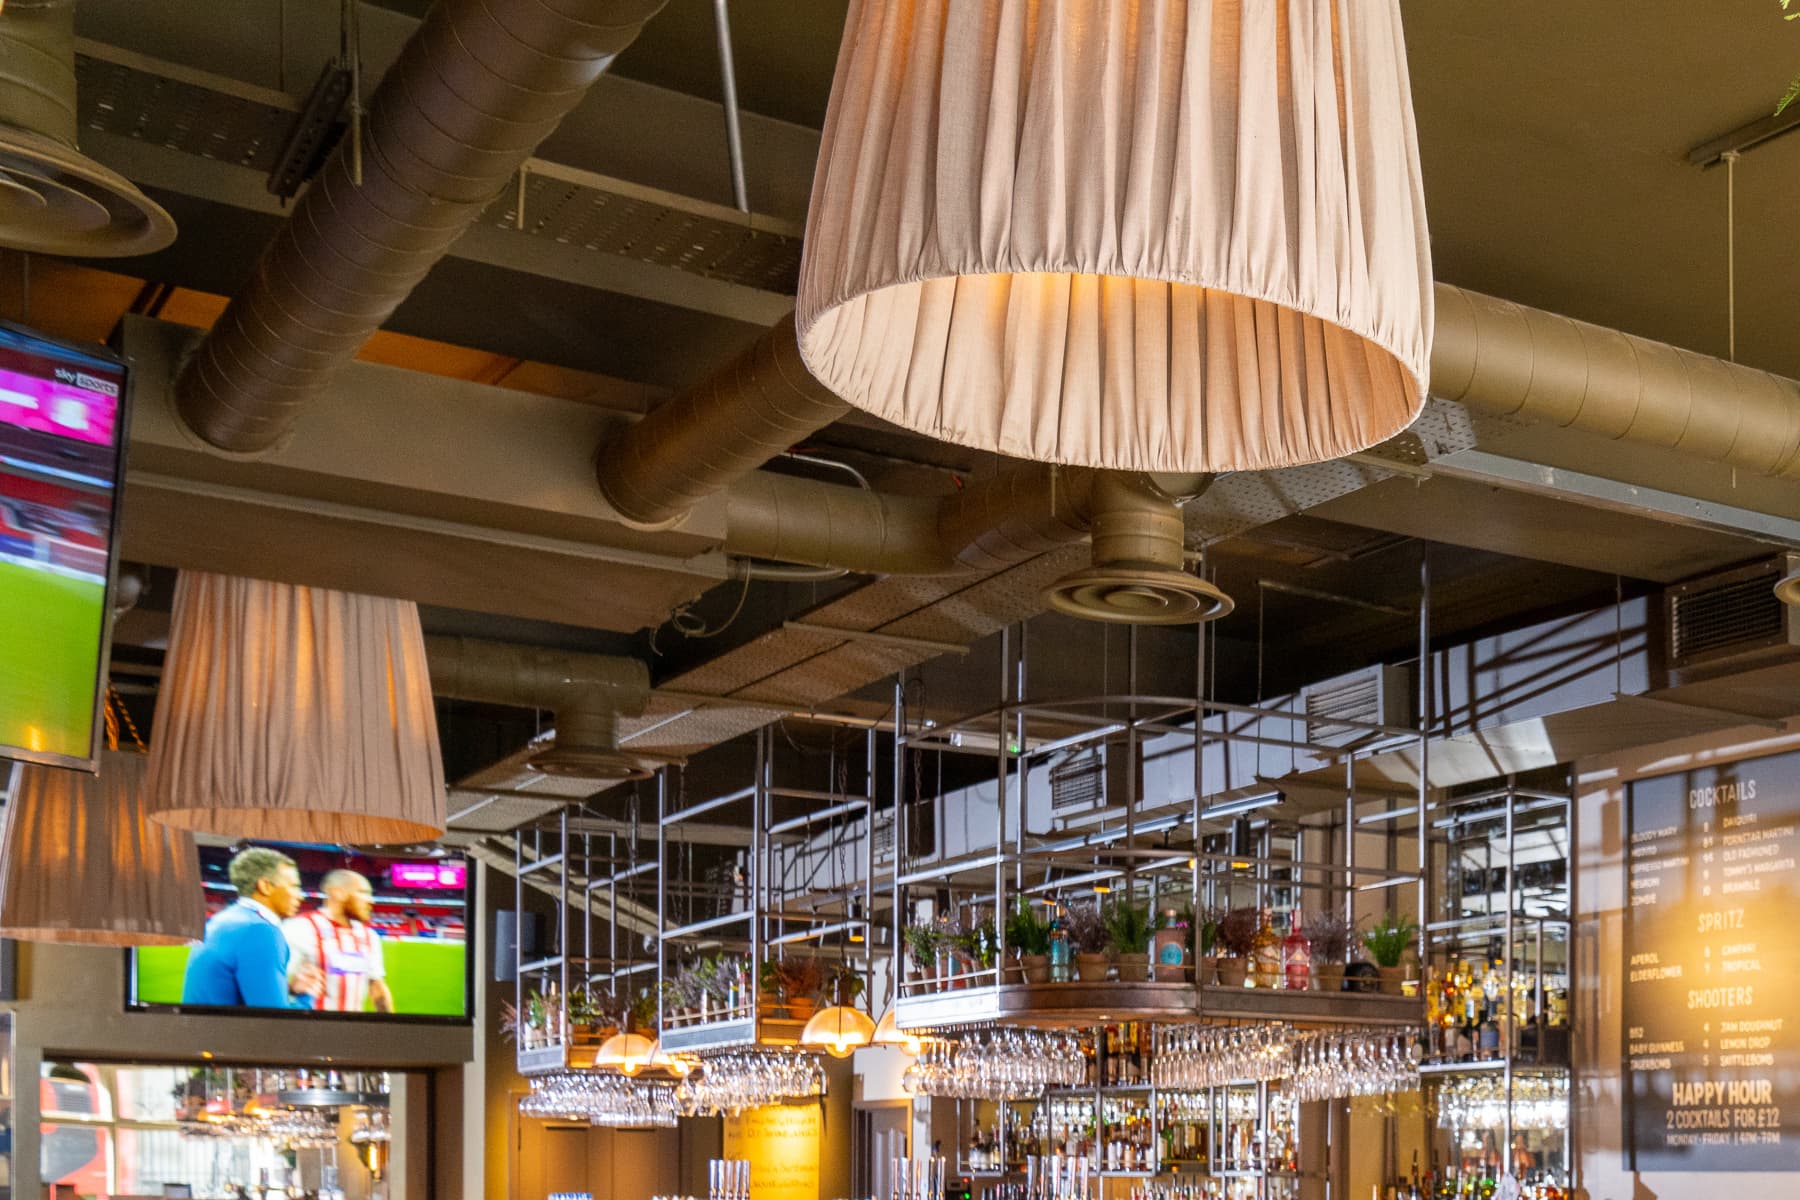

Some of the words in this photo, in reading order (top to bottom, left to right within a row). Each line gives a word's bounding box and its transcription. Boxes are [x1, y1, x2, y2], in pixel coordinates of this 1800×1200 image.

[1690, 780, 1756, 809] COCKTAILS
[1722, 849, 1737, 862] OLD
[1722, 878, 1760, 894] BRAMBLE
[1698, 908, 1744, 933] SPRITZ
[1631, 952, 1659, 965] APEROL
[1721, 959, 1761, 972] TROPICAL
[1630, 965, 1682, 983] ELDERFLOWER
[1687, 985, 1753, 1009] SHOOTERS
[1720, 1021, 1738, 1033] JAM
[1739, 1018, 1784, 1032] DOUGHNUT
[1629, 1043, 1648, 1055] BABY
[1649, 1040, 1685, 1054] GUINNESS
[1720, 1038, 1747, 1050] LEMON
[1748, 1036, 1771, 1048] DROP
[1720, 1053, 1774, 1067] SKITTLEBOMB
[1672, 1081, 1725, 1107] HAPPY
[1728, 1079, 1772, 1106] HOUR
[1666, 1110, 1674, 1129] 2
[1676, 1108, 1730, 1129] COCKTAILS
[1734, 1108, 1756, 1128] FOR
[1757, 1107, 1780, 1128] £12
